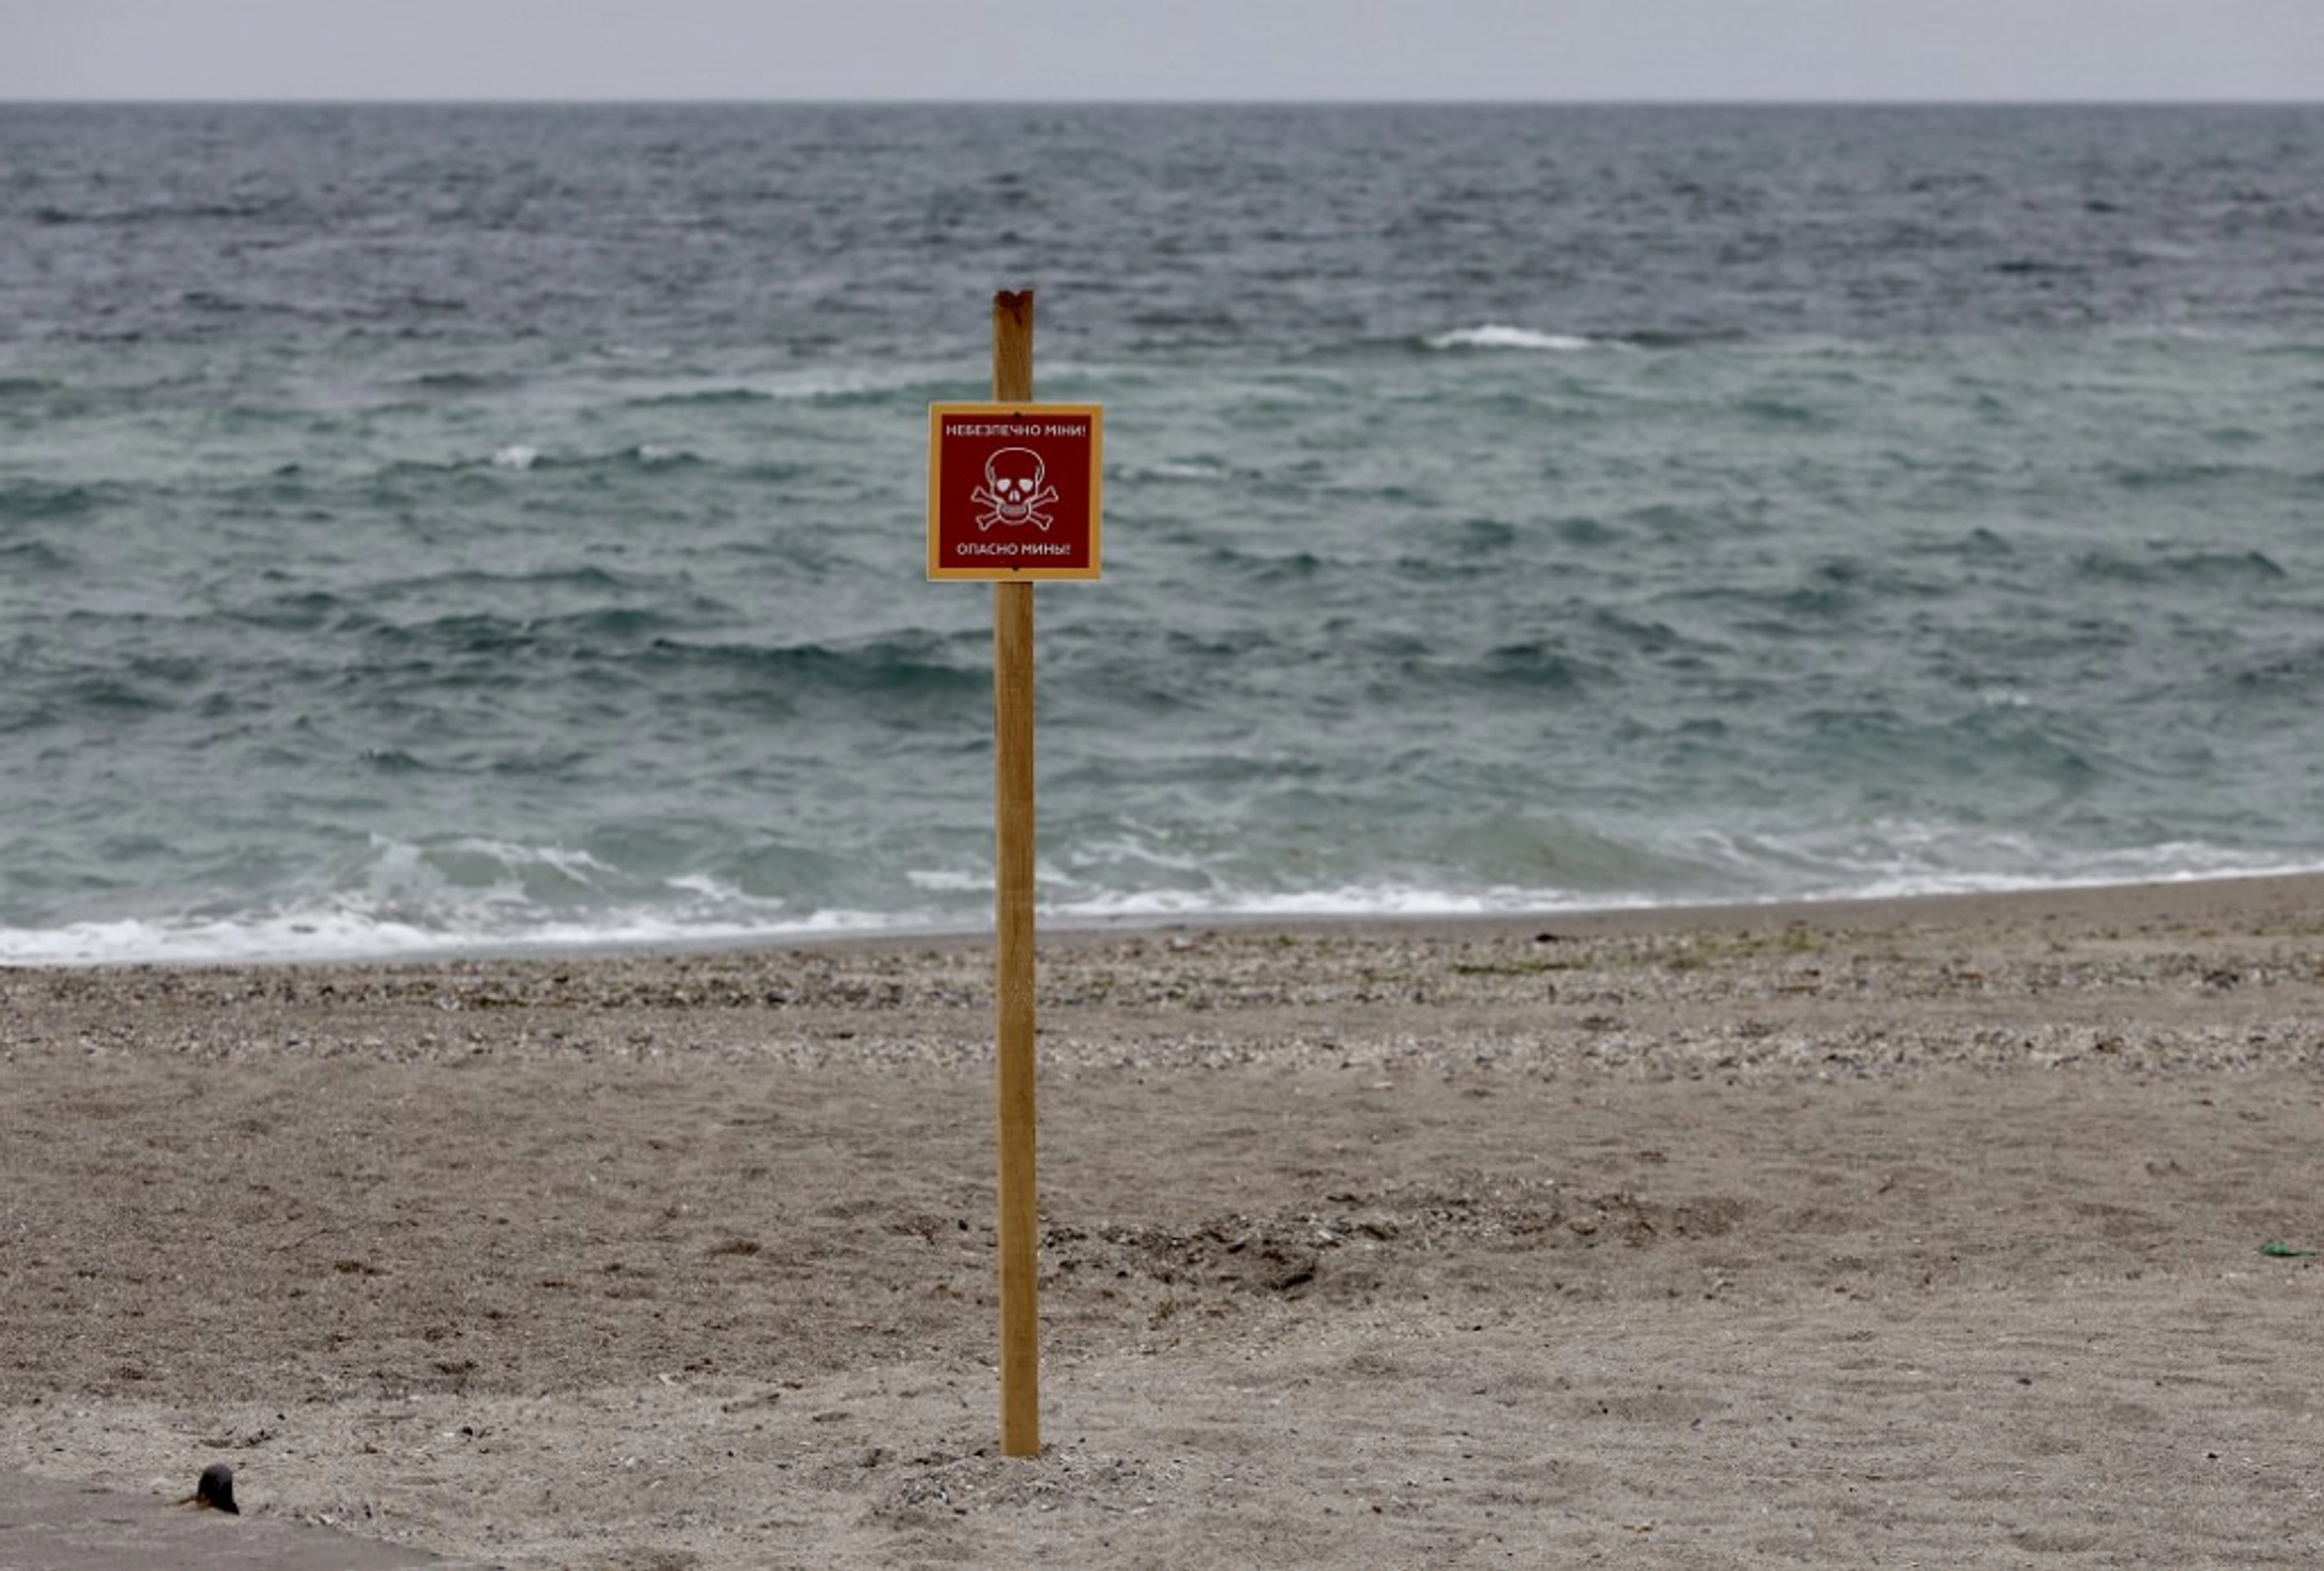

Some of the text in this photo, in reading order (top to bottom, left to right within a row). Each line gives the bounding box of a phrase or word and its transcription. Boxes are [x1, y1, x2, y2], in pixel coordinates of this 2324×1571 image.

[946, 424, 1087, 437] НЕБЕЗПЕЧНО МІНИ!
[957, 543, 1071, 555] ОПАСНО МИНЫ!
